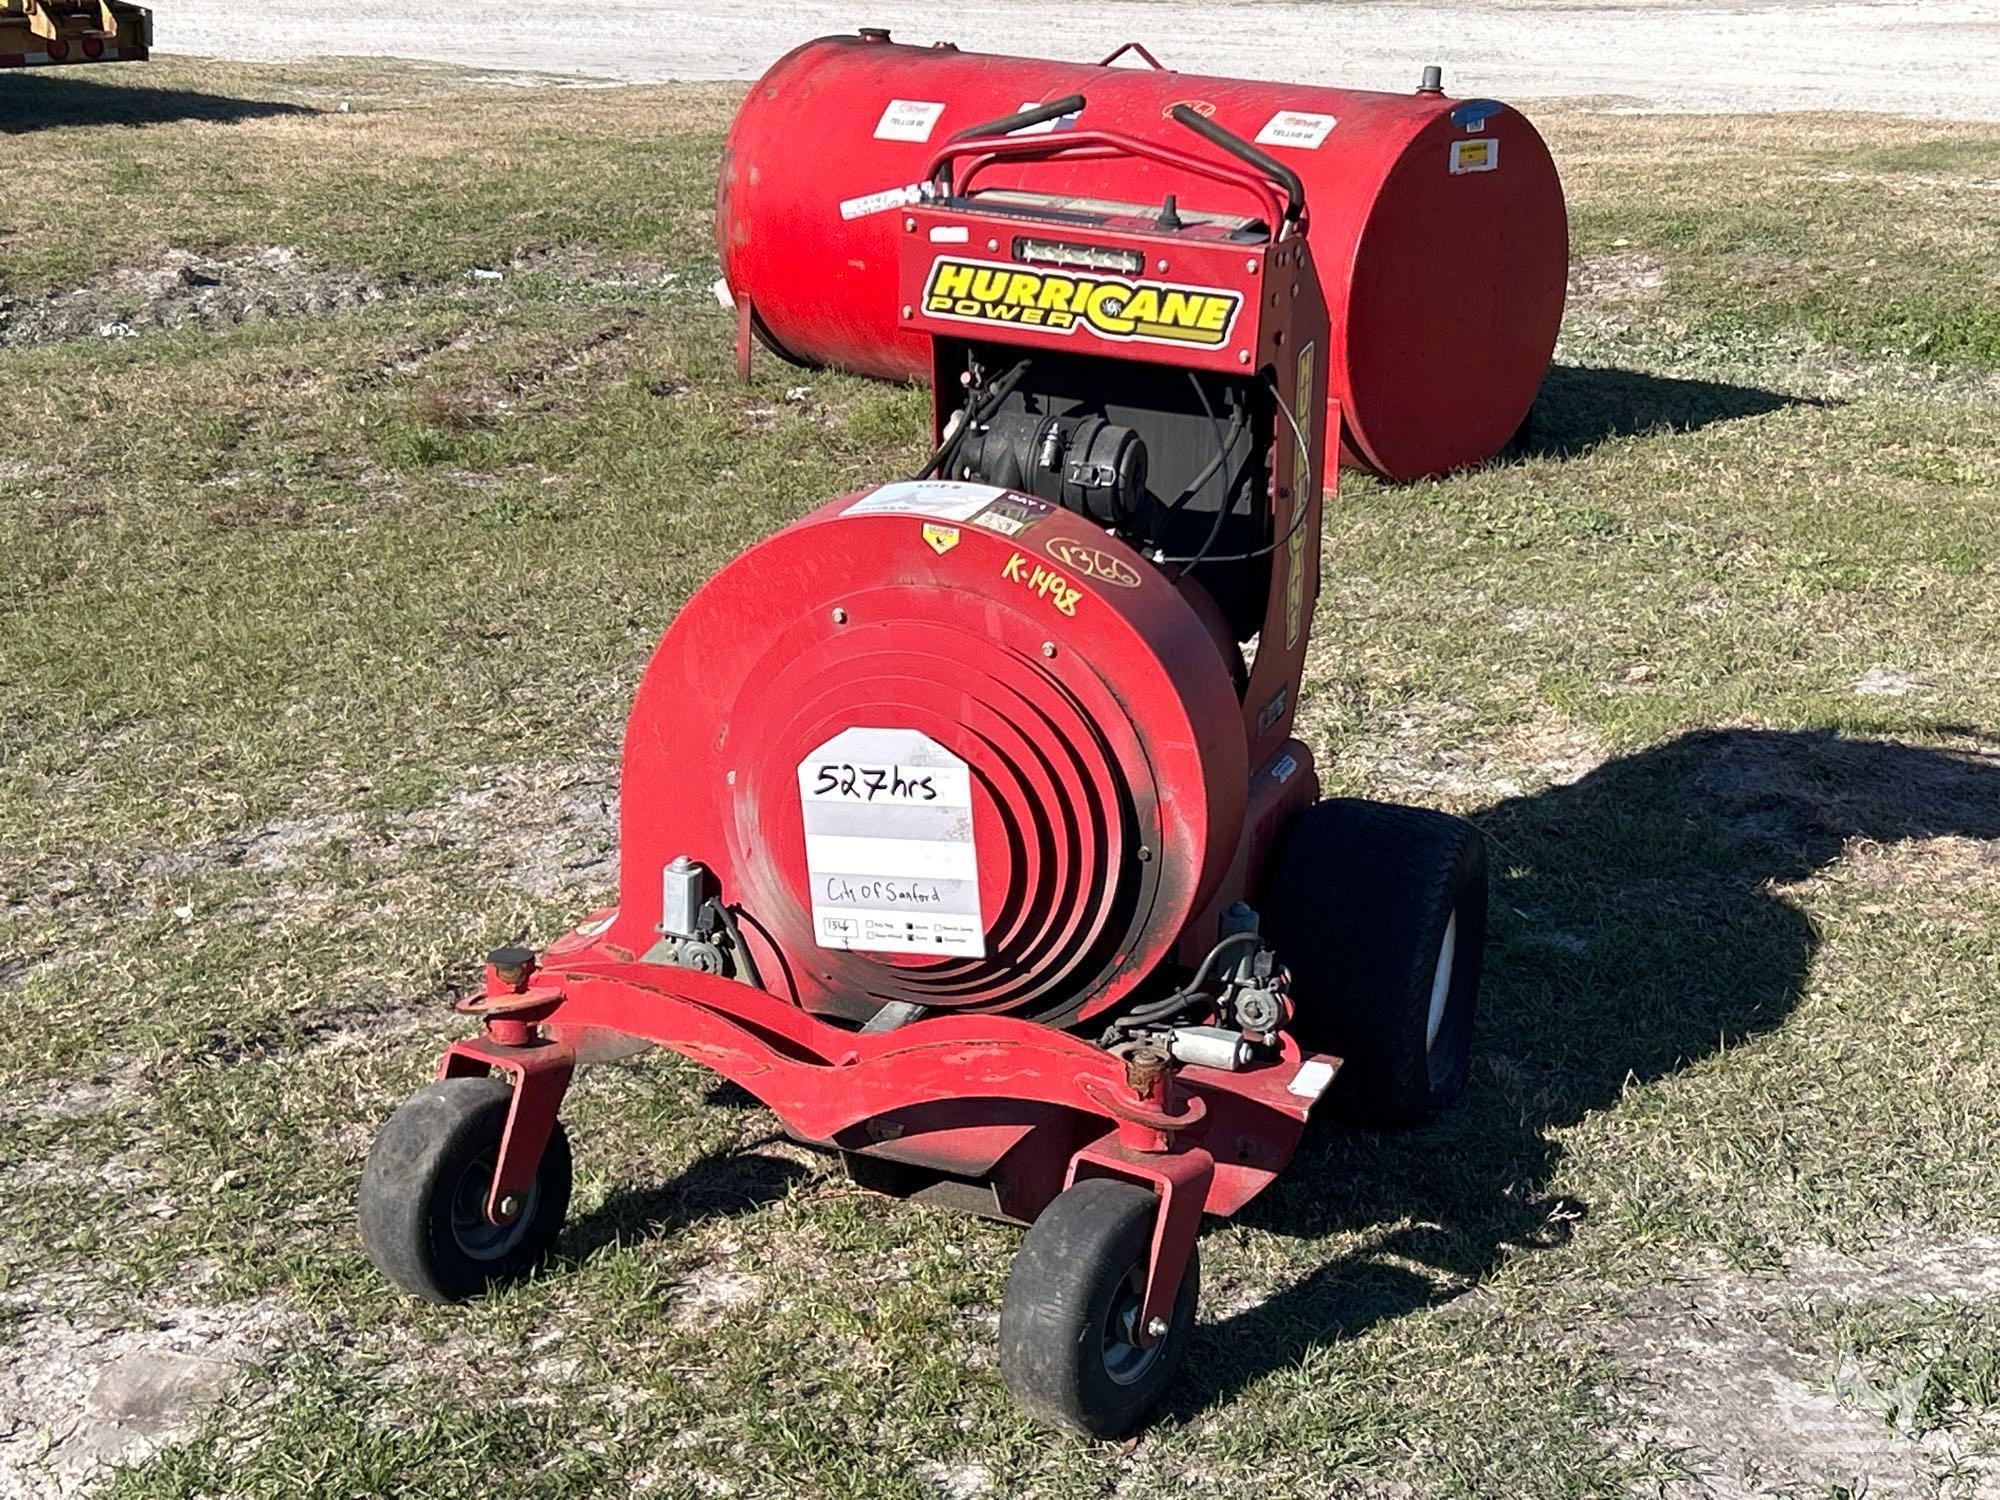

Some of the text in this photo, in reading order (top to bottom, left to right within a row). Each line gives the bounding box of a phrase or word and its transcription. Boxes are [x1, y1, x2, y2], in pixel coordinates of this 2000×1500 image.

[928, 296, 1074, 327] POWER
[933, 264, 1234, 332] HURRICANE
[1001, 552, 1084, 618] K-1498
[886, 883, 942, 904] Sanford
